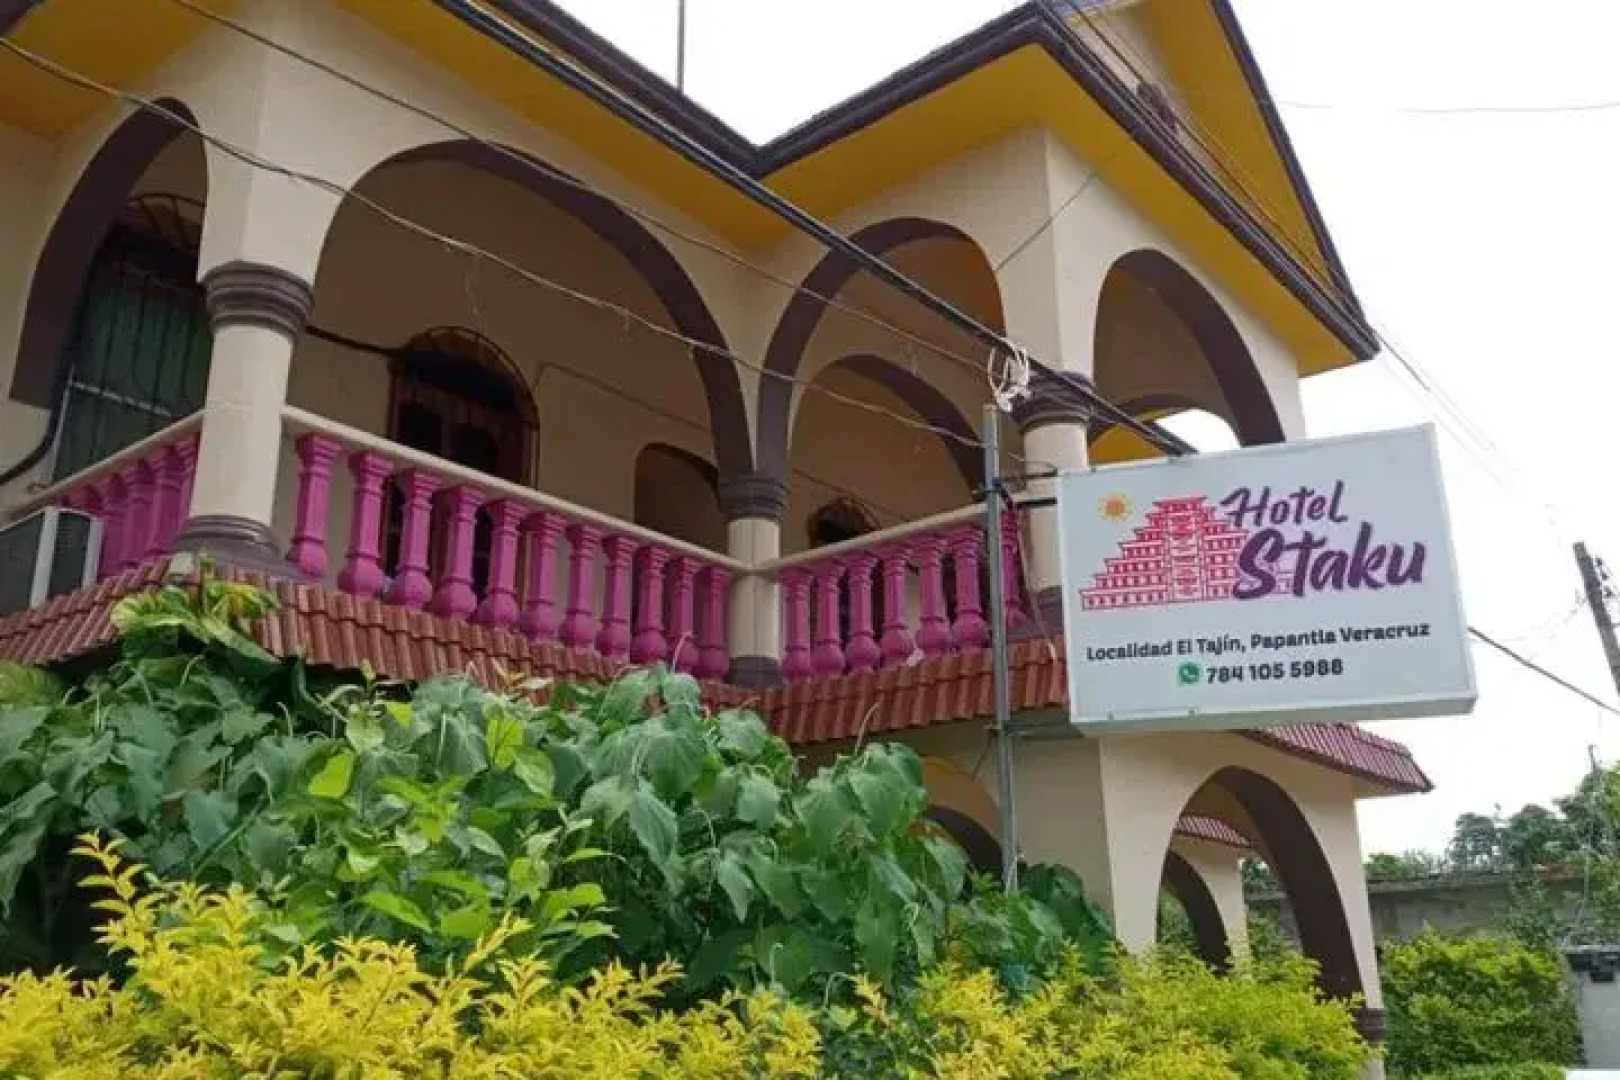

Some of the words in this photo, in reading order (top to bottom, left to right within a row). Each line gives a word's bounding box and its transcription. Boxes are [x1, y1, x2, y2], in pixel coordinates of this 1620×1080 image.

[1219, 479, 1349, 527] Hotel
[1232, 521, 1426, 599] Staku
[1086, 639, 1173, 661] Localidad
[1176, 638, 1193, 655] El
[1197, 633, 1247, 656] Tajín,
[1251, 629, 1337, 651] Papantla
[1340, 622, 1431, 643] Veracruz
[1205, 665, 1243, 685] 784
[1249, 663, 1285, 681] 105
